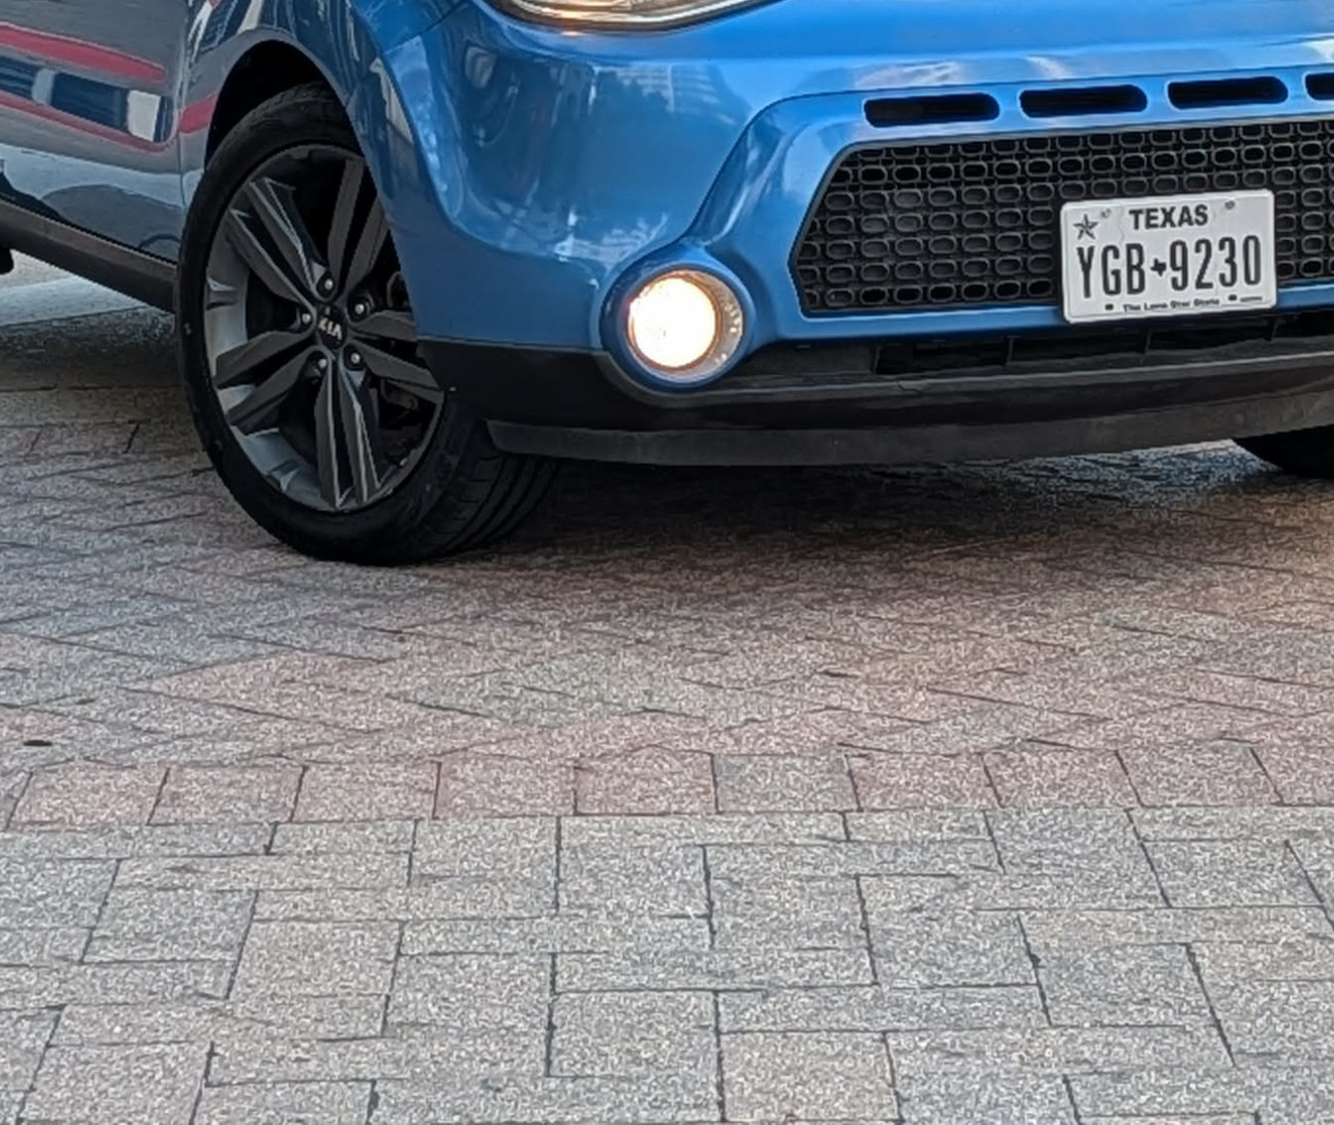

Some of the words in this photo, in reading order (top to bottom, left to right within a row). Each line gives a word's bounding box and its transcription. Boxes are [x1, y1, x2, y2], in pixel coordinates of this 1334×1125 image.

[1128, 203, 1209, 231] TEXAS
[1076, 242, 1146, 299] YGB
[1169, 234, 1262, 292] 9230
[318, 316, 343, 341] KIA
